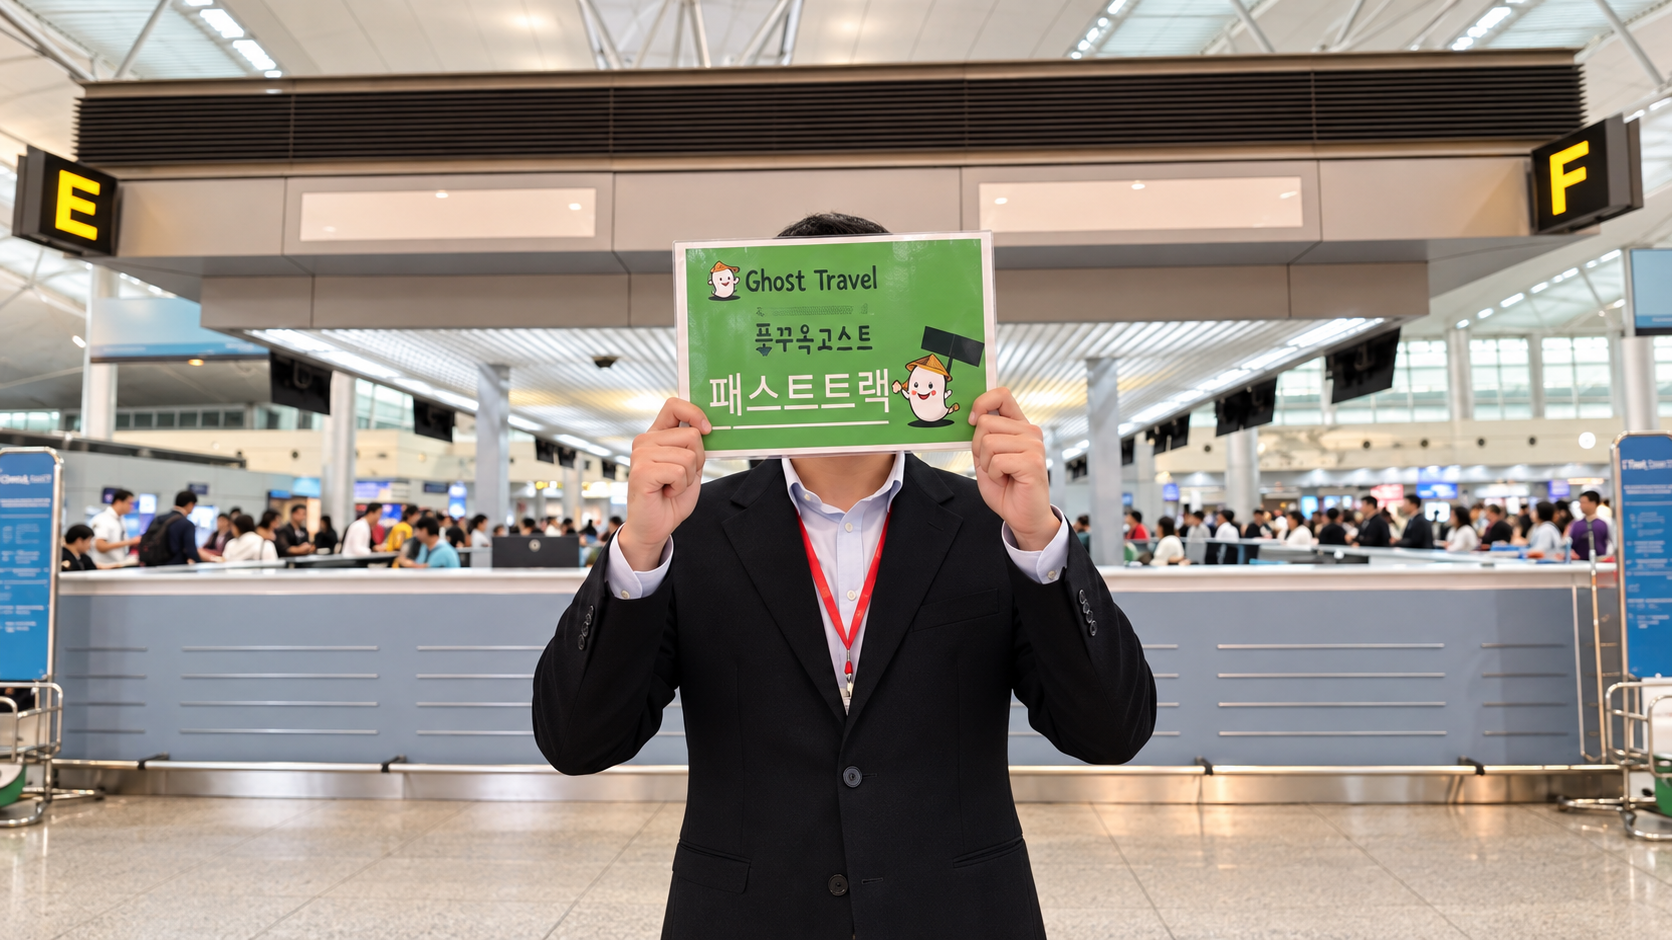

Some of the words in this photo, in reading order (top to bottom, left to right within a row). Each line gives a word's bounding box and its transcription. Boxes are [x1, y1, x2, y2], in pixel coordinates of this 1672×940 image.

[55, 169, 100, 241] E
[1549, 140, 1589, 216] F
[745, 268, 806, 293] Ghost
[813, 265, 878, 291] Travel
[709, 368, 890, 417] 패스트트랙
